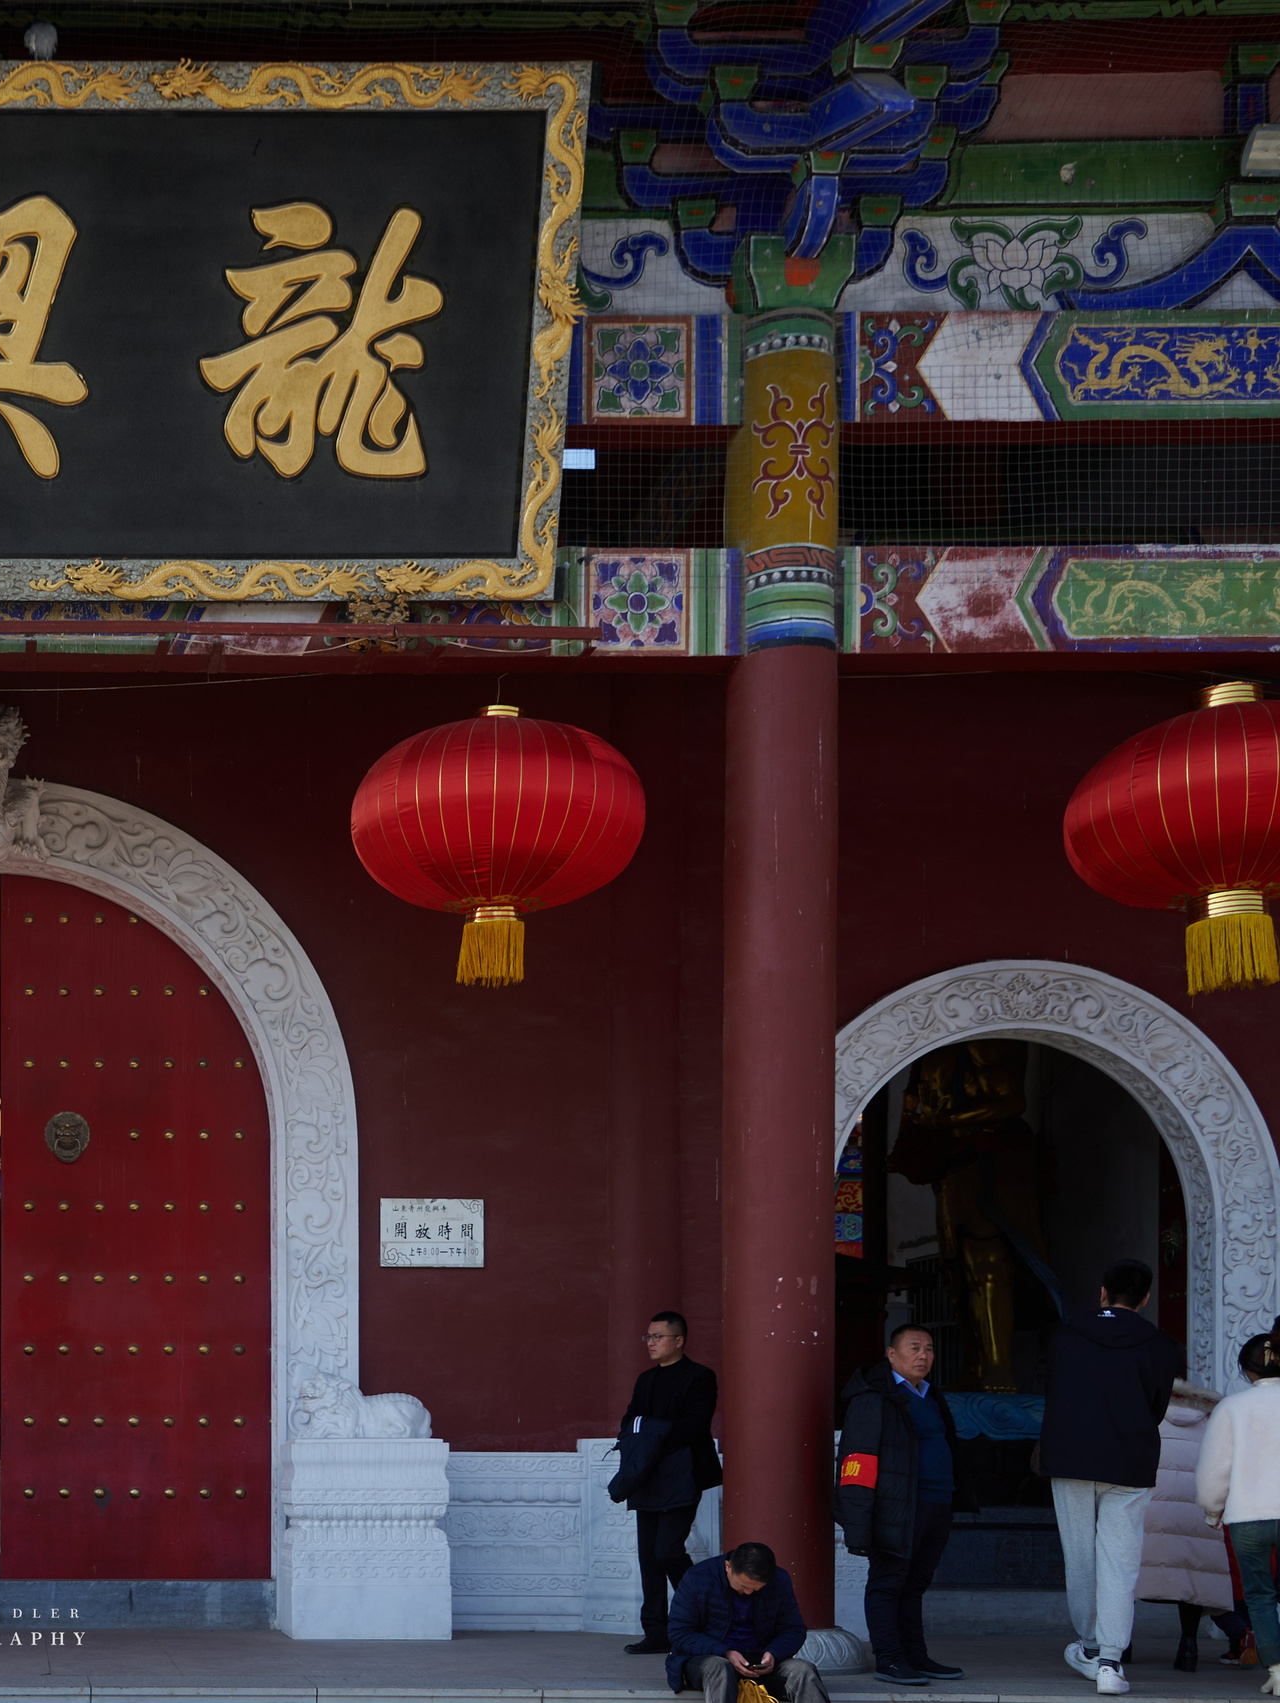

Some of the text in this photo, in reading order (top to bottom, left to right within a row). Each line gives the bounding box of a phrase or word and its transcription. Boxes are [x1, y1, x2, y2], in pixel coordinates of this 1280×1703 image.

[394, 1221, 474, 1241] 開放時間
[840, 1460, 861, 1478] 勤
